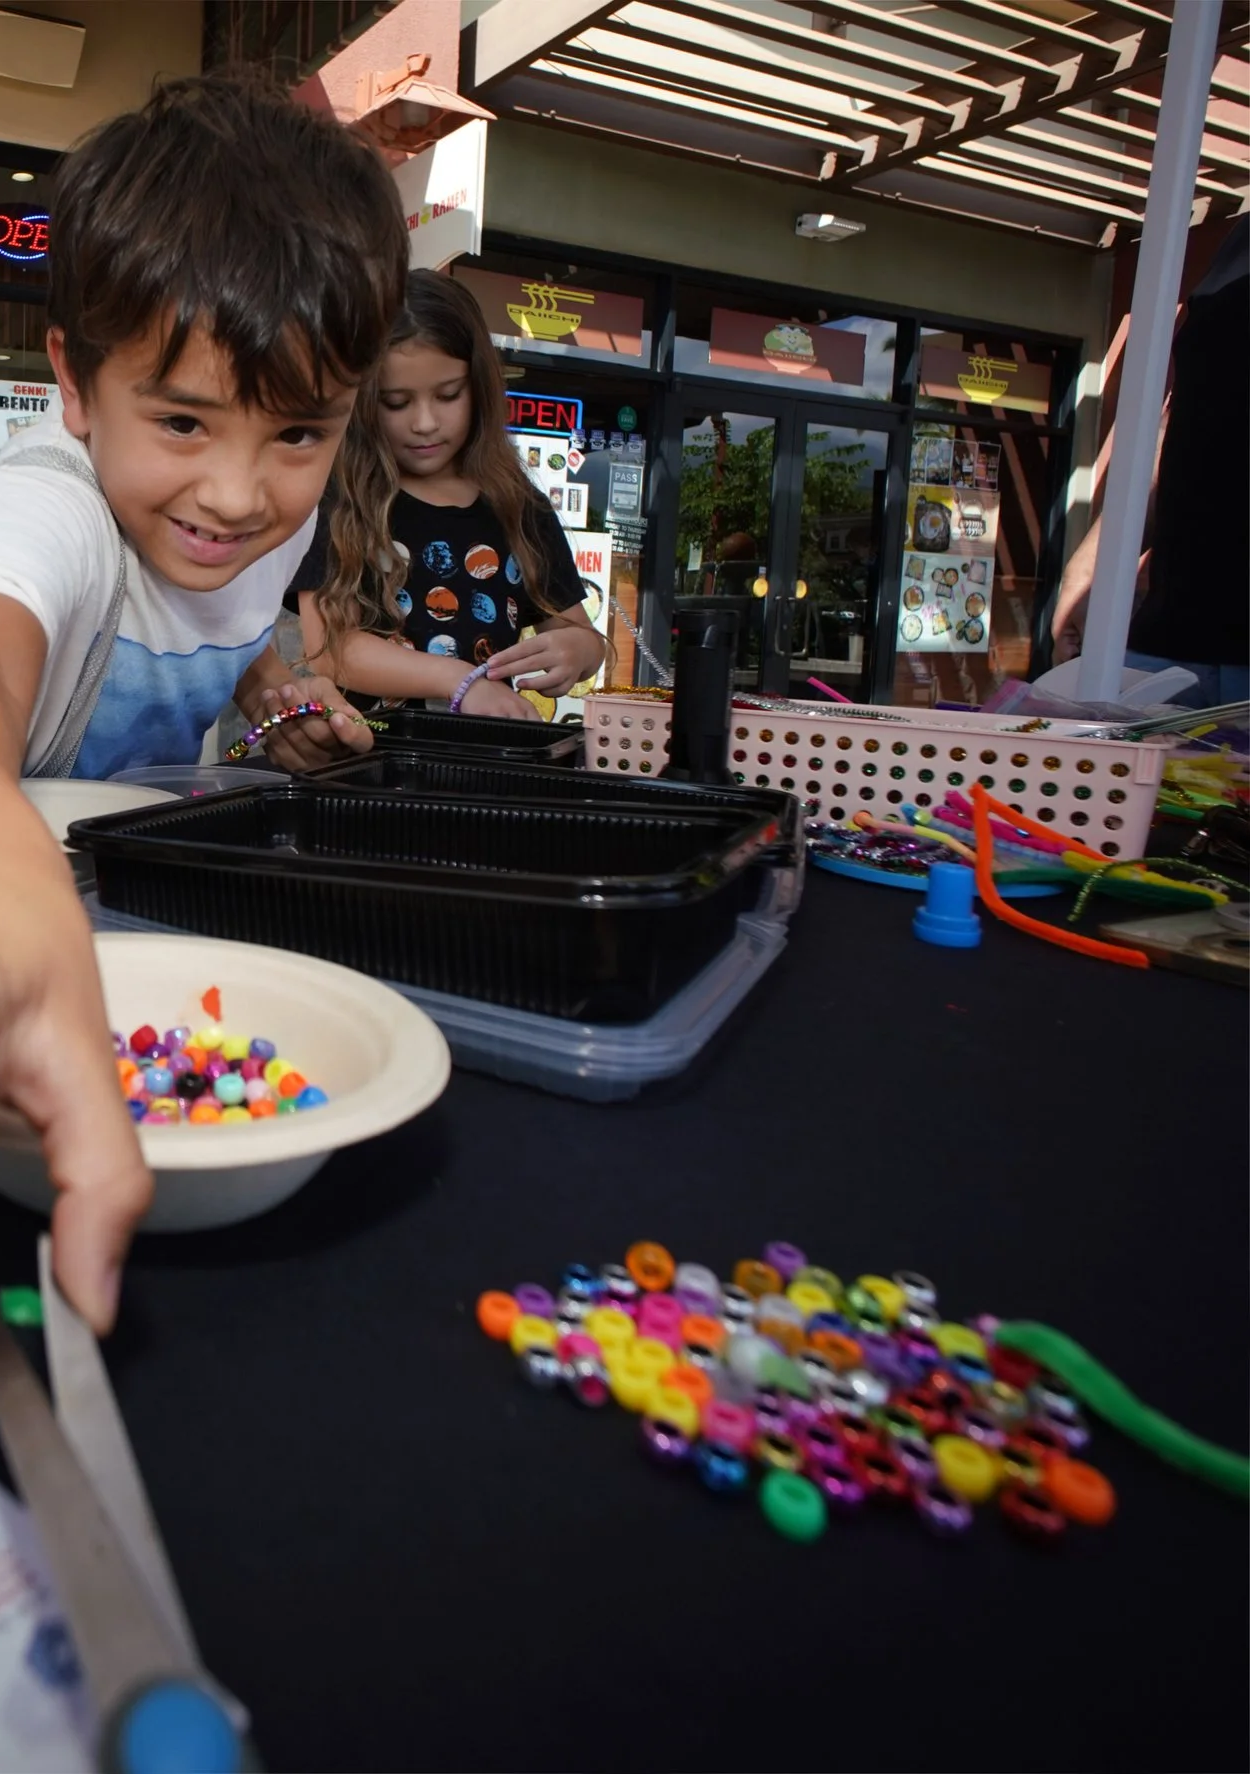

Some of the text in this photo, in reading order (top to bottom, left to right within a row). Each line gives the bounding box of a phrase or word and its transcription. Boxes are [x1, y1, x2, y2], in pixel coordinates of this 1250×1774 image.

[432, 187, 467, 219] RAMEN
[13, 385, 47, 396] GENKI
[0, 396, 49, 412] BENTO
[615, 472, 638, 483] PASS
[576, 551, 603, 573] MEN
